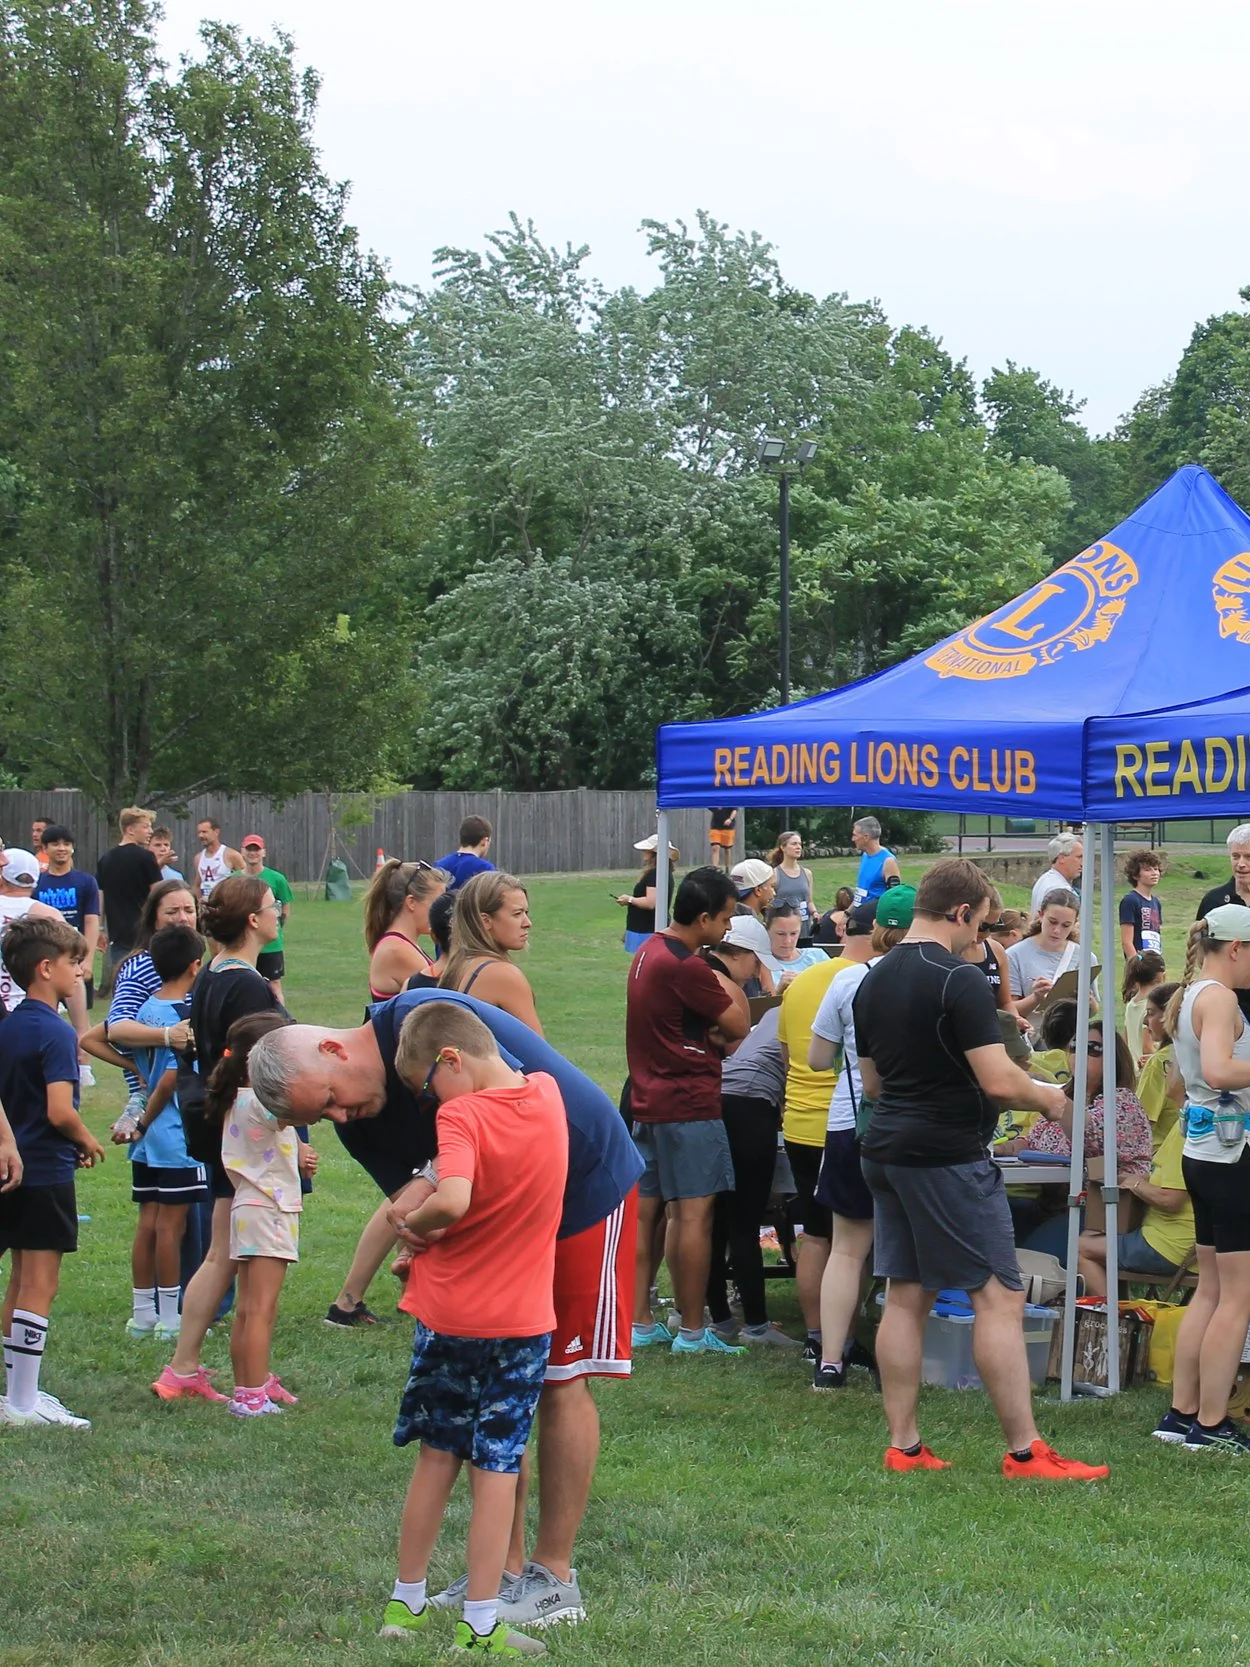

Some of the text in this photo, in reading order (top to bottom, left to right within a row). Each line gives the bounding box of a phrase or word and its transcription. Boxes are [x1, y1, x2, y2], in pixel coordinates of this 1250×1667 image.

[1074, 544, 1134, 592] ONS
[714, 741, 1036, 794] READING LIONS CLUB
[25, 1328, 42, 1340] NIKE
[1083, 1320, 1128, 1334] groces
[564, 1344, 583, 1354] adidas
[534, 1593, 561, 1612] HOKA
